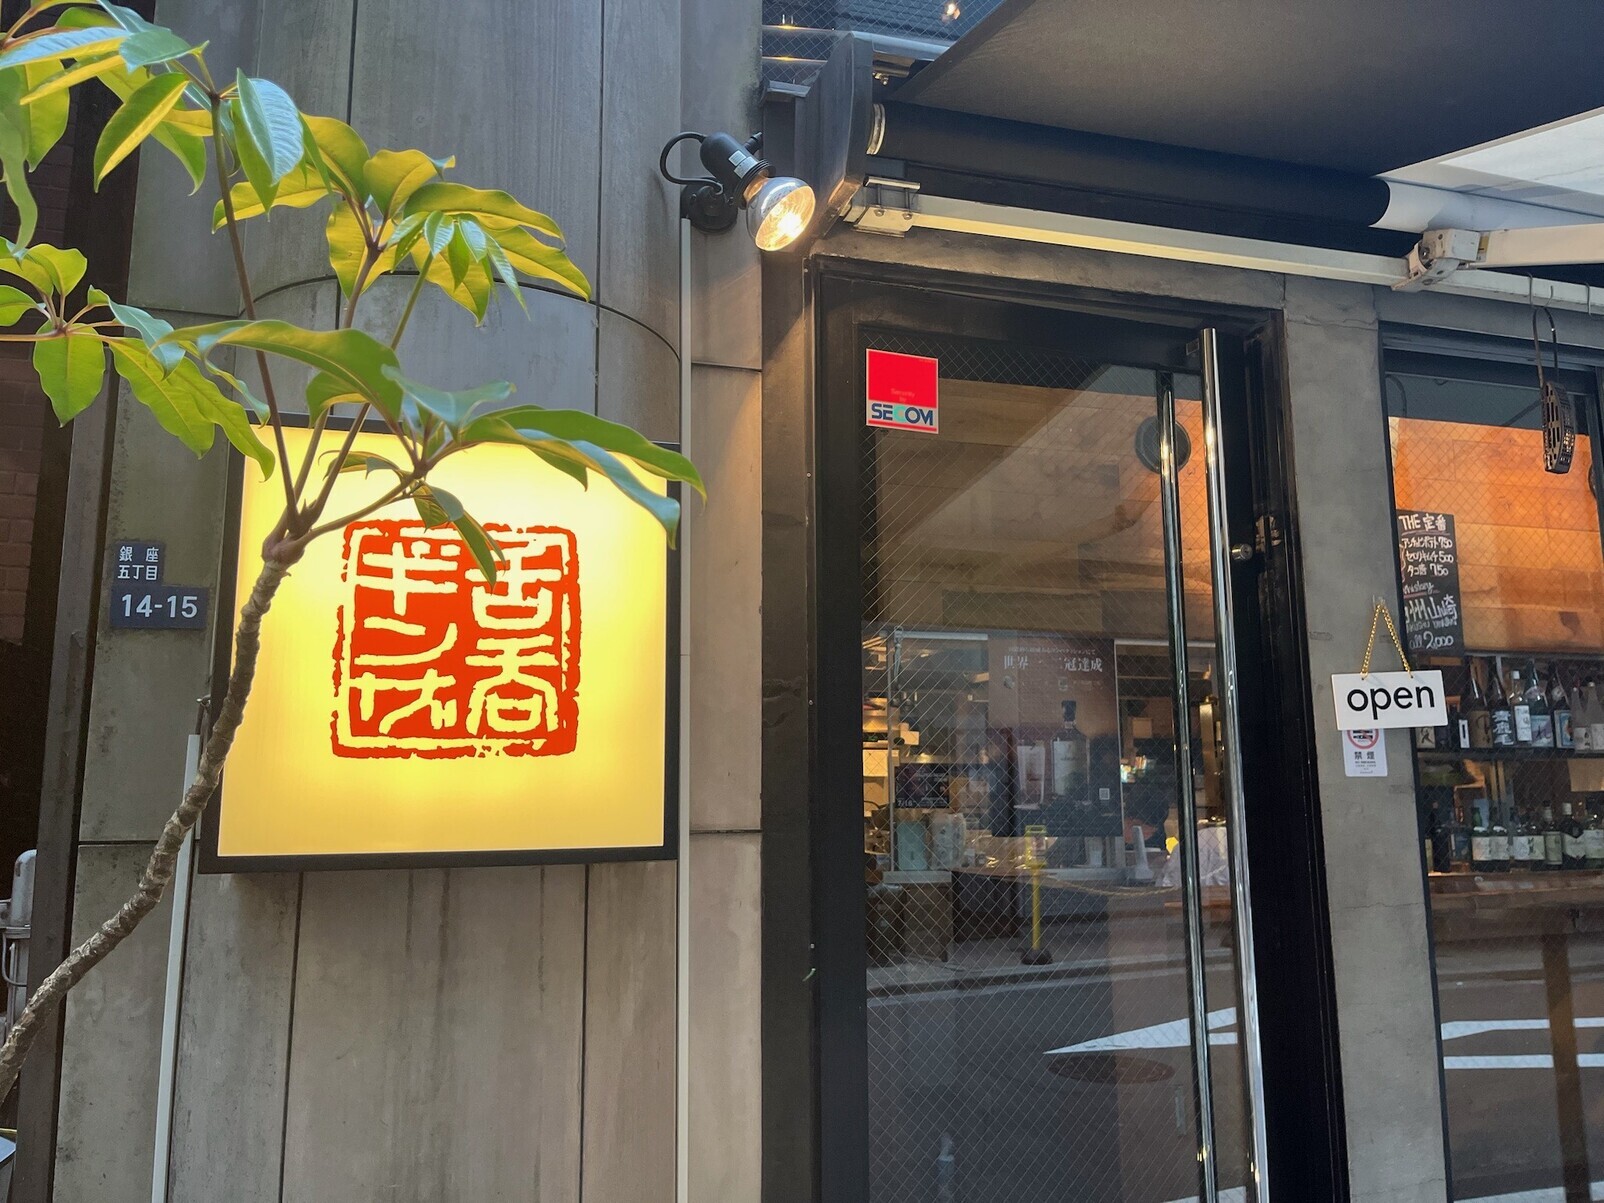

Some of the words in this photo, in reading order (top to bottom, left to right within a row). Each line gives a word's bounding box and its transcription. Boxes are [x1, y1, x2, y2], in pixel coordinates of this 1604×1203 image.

[871, 402, 934, 426] SECOM
[1398, 513, 1421, 531] THE
[1422, 513, 1447, 532] 定番
[1438, 536, 1453, 549] 750
[119, 545, 159, 562] 銀座
[1438, 550, 1454, 563] 500
[117, 564, 158, 580] 五丁目
[1429, 563, 1449, 576] 750
[121, 594, 198, 618] 14-15
[1347, 686, 1435, 720] open
